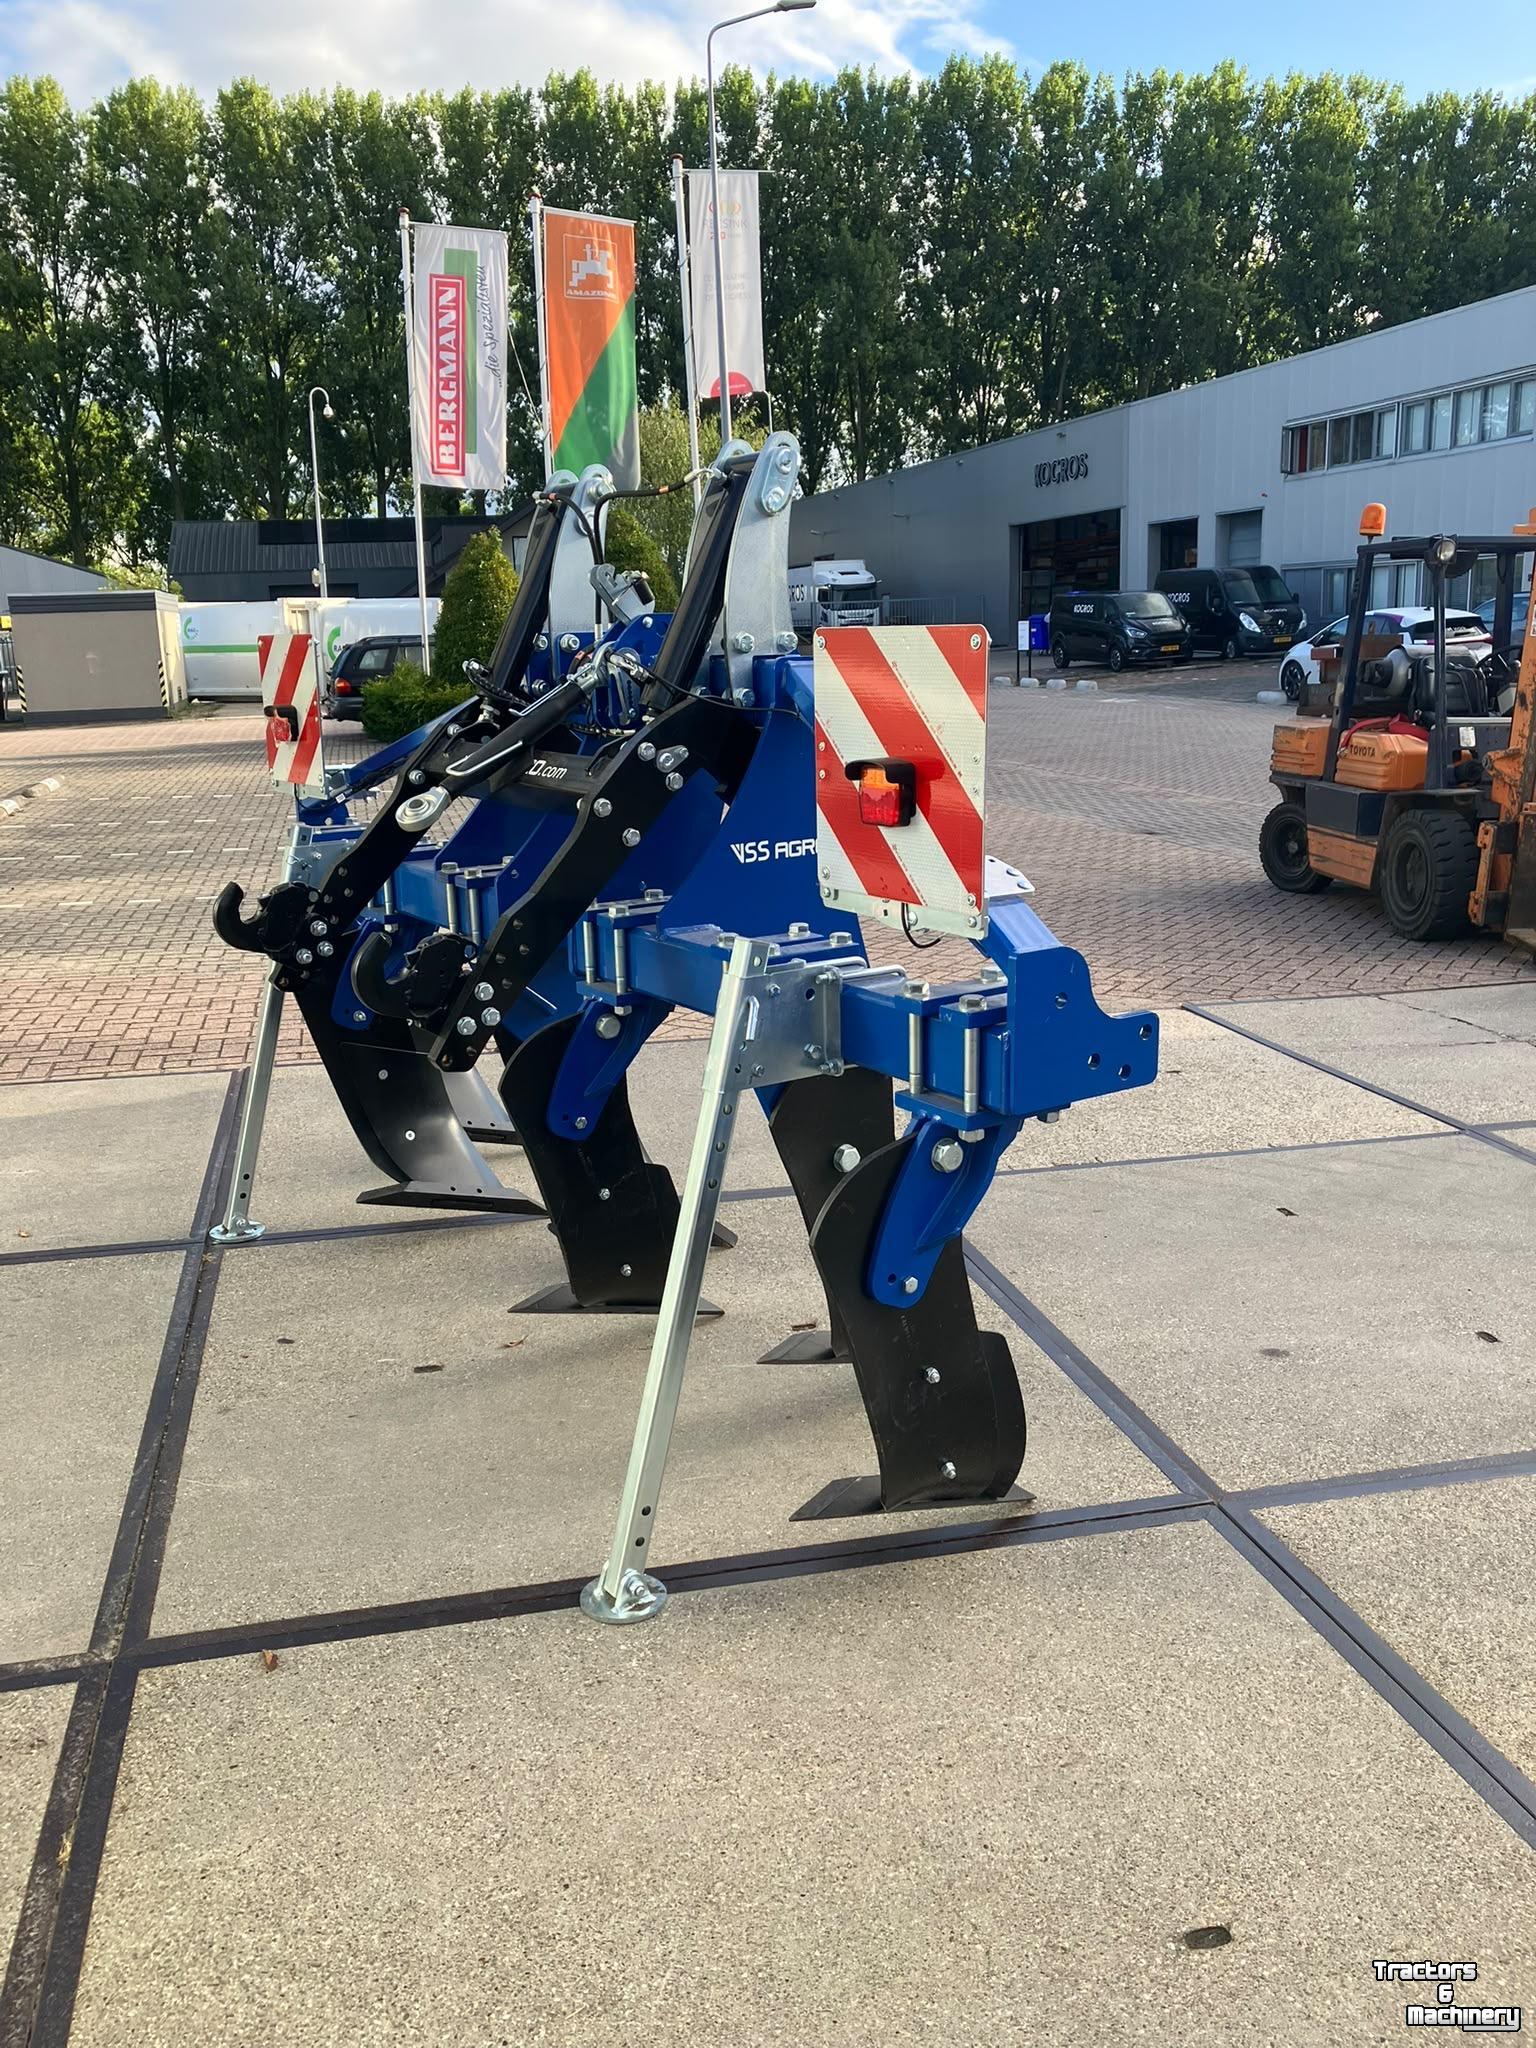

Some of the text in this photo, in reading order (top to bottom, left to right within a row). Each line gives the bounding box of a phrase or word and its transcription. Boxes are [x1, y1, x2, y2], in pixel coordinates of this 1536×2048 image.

[704, 219, 747, 229] RESINK
[438, 286, 457, 466] BERGMANN
[1034, 452, 1089, 488] KOGROS
[788, 584, 805, 602] ROS
[1073, 604, 1094, 613] KOGROS
[1349, 744, 1376, 758] TOYOTA
[730, 838, 818, 863] VSS AGR
